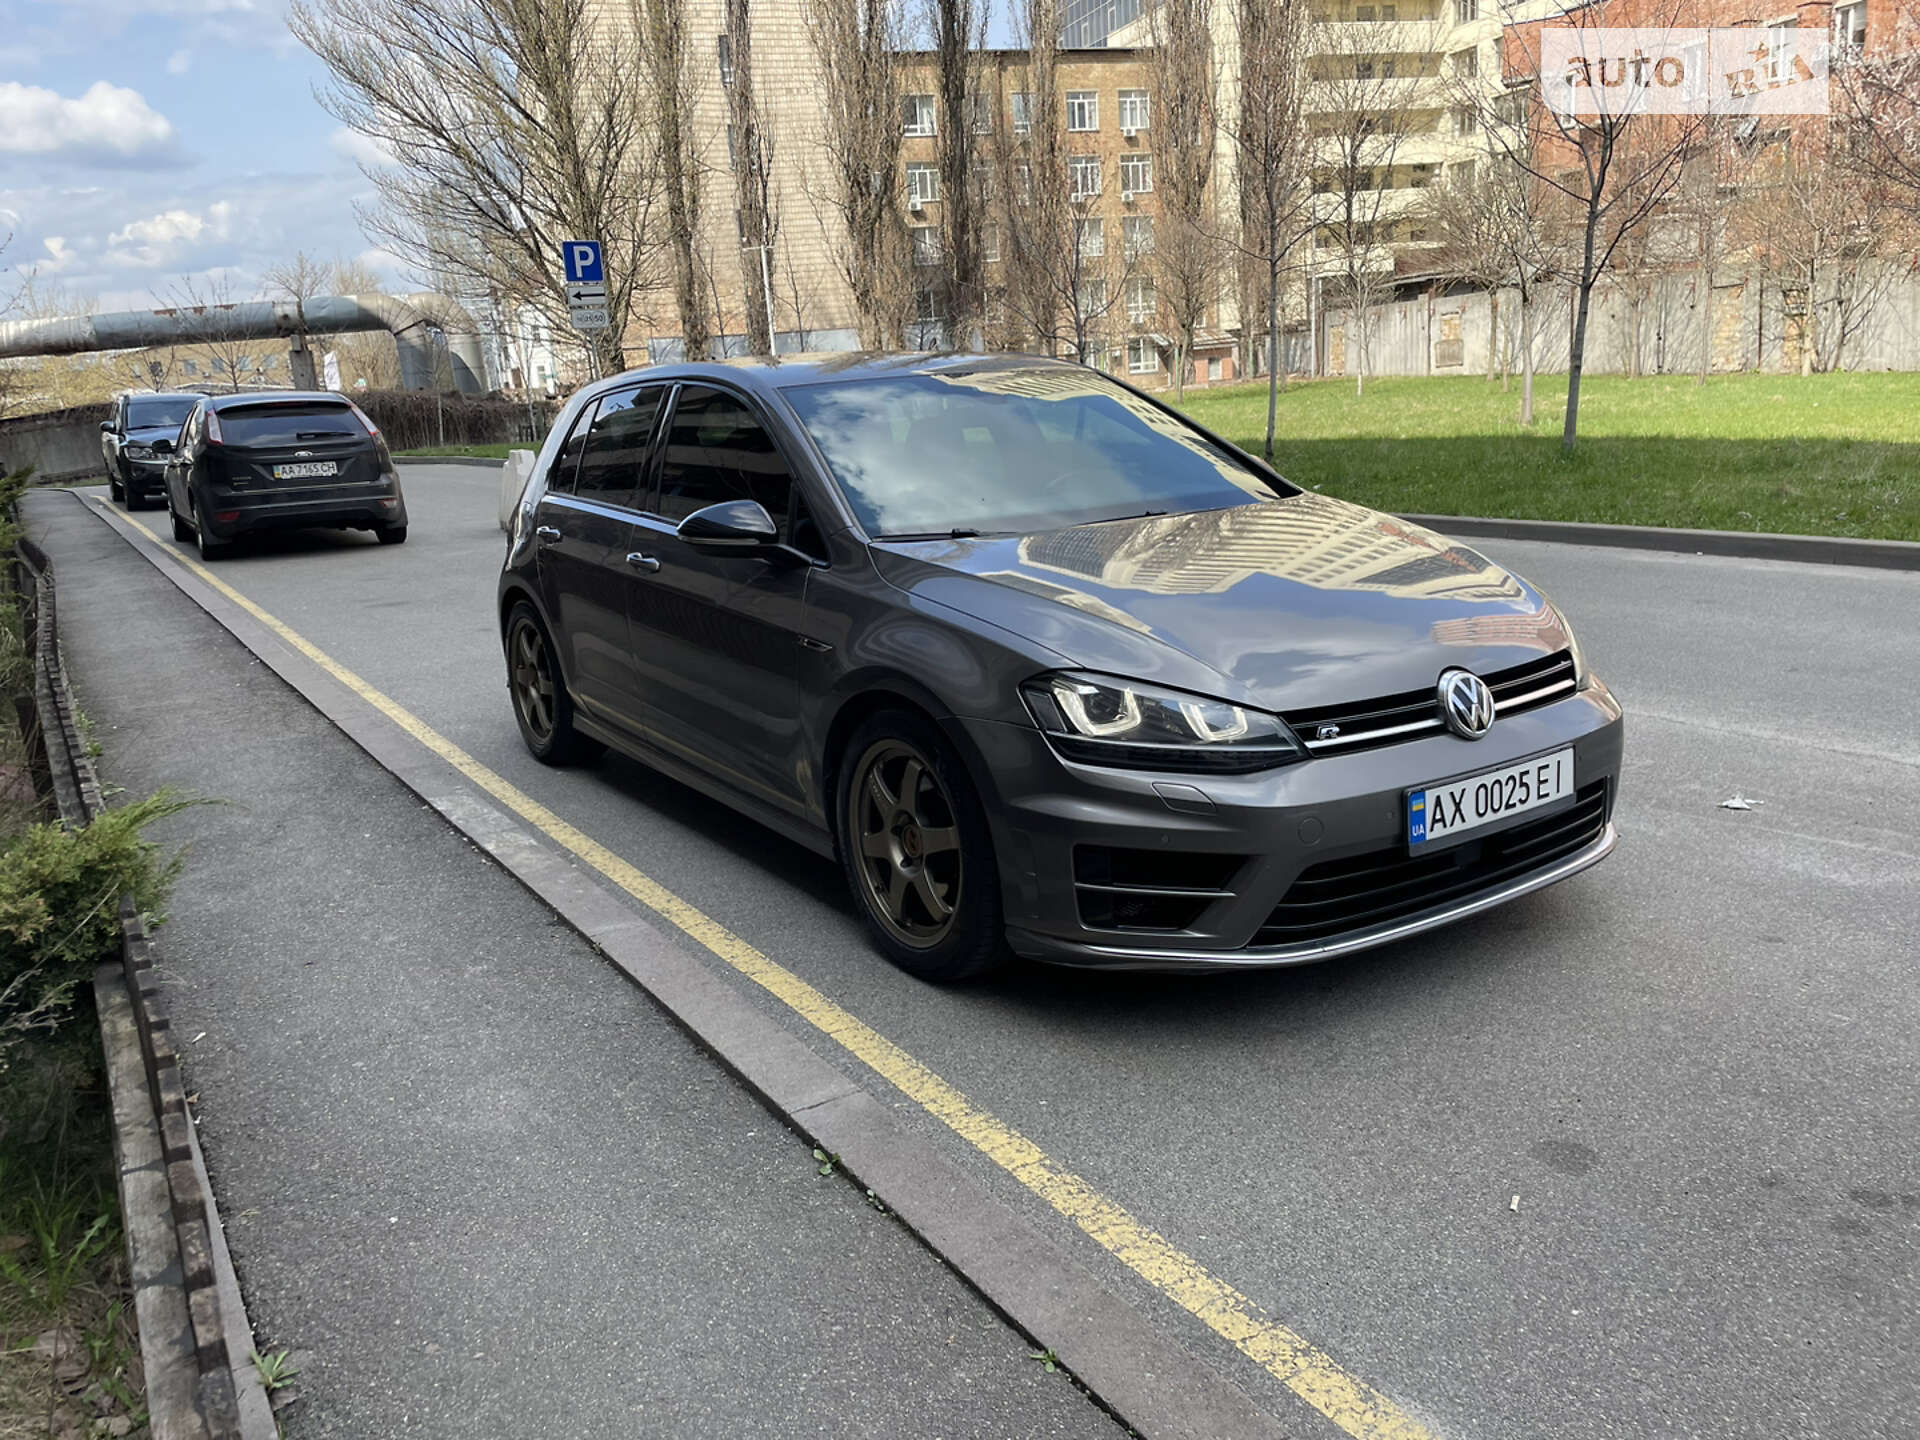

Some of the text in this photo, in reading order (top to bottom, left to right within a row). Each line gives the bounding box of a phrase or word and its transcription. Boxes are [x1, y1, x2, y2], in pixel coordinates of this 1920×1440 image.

[573, 245, 595, 278] P
[1430, 760, 1561, 833] AX 0025 EI
[1411, 823, 1425, 838] UA
